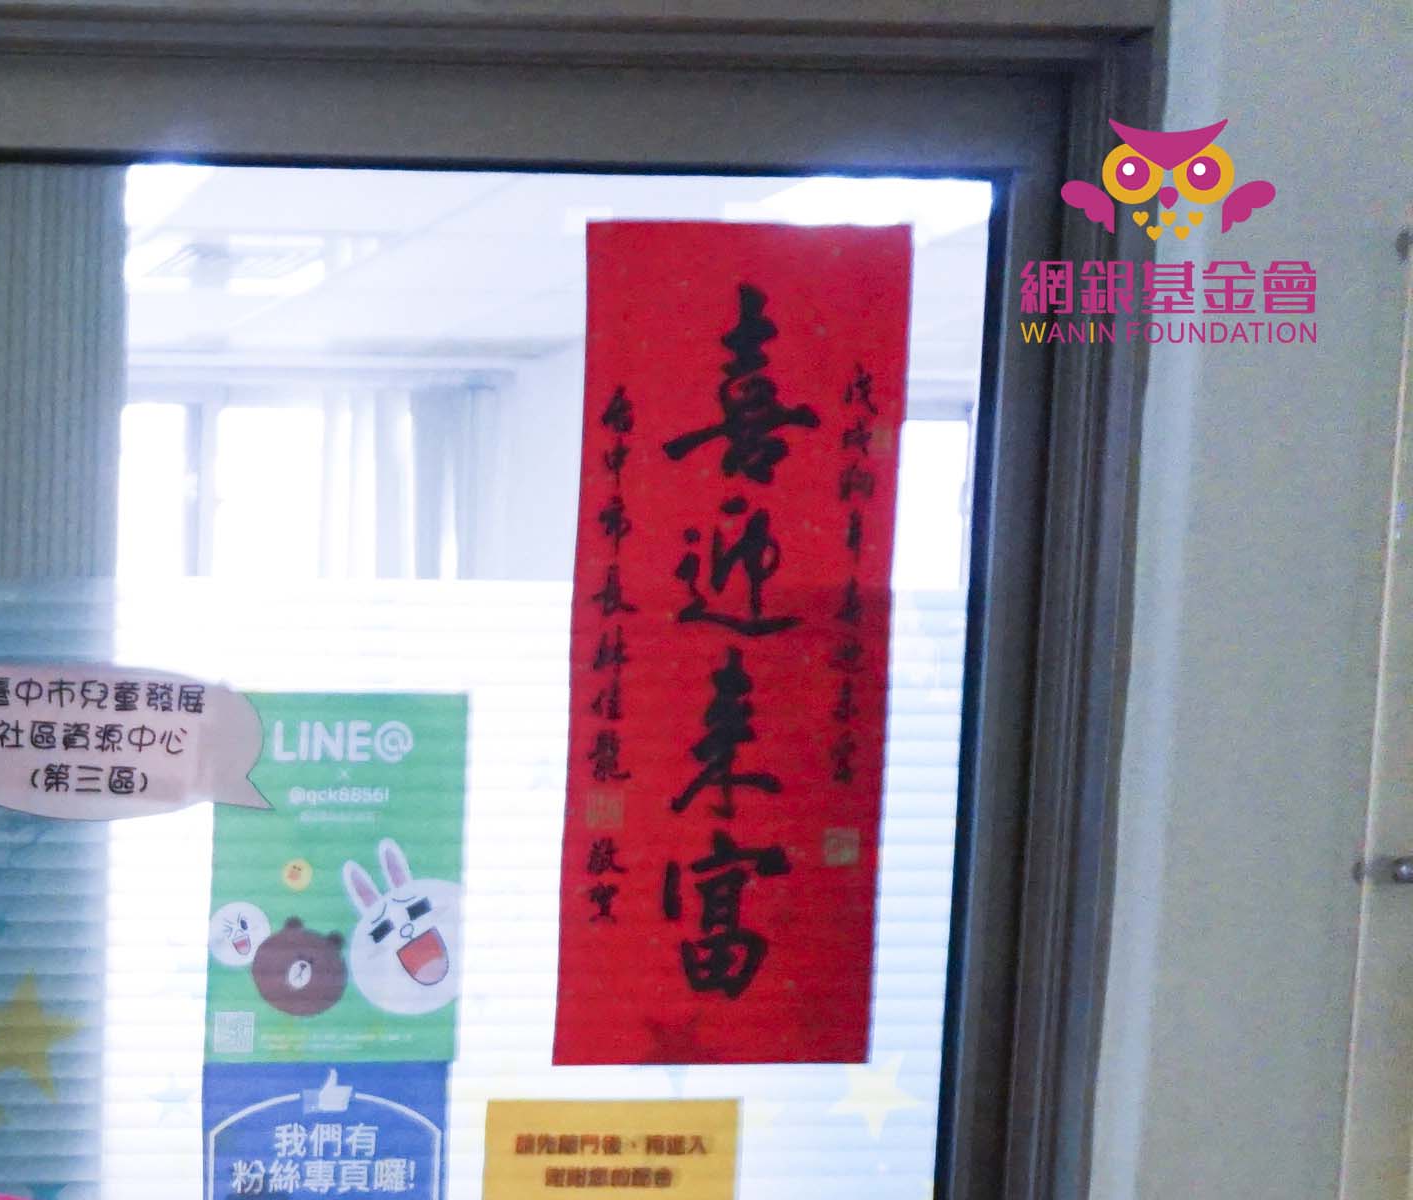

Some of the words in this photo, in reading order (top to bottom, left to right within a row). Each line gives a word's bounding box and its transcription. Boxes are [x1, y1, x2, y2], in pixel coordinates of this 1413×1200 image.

[274, 719, 415, 764] LINE@
[274, 1122, 379, 1157] 我們有
